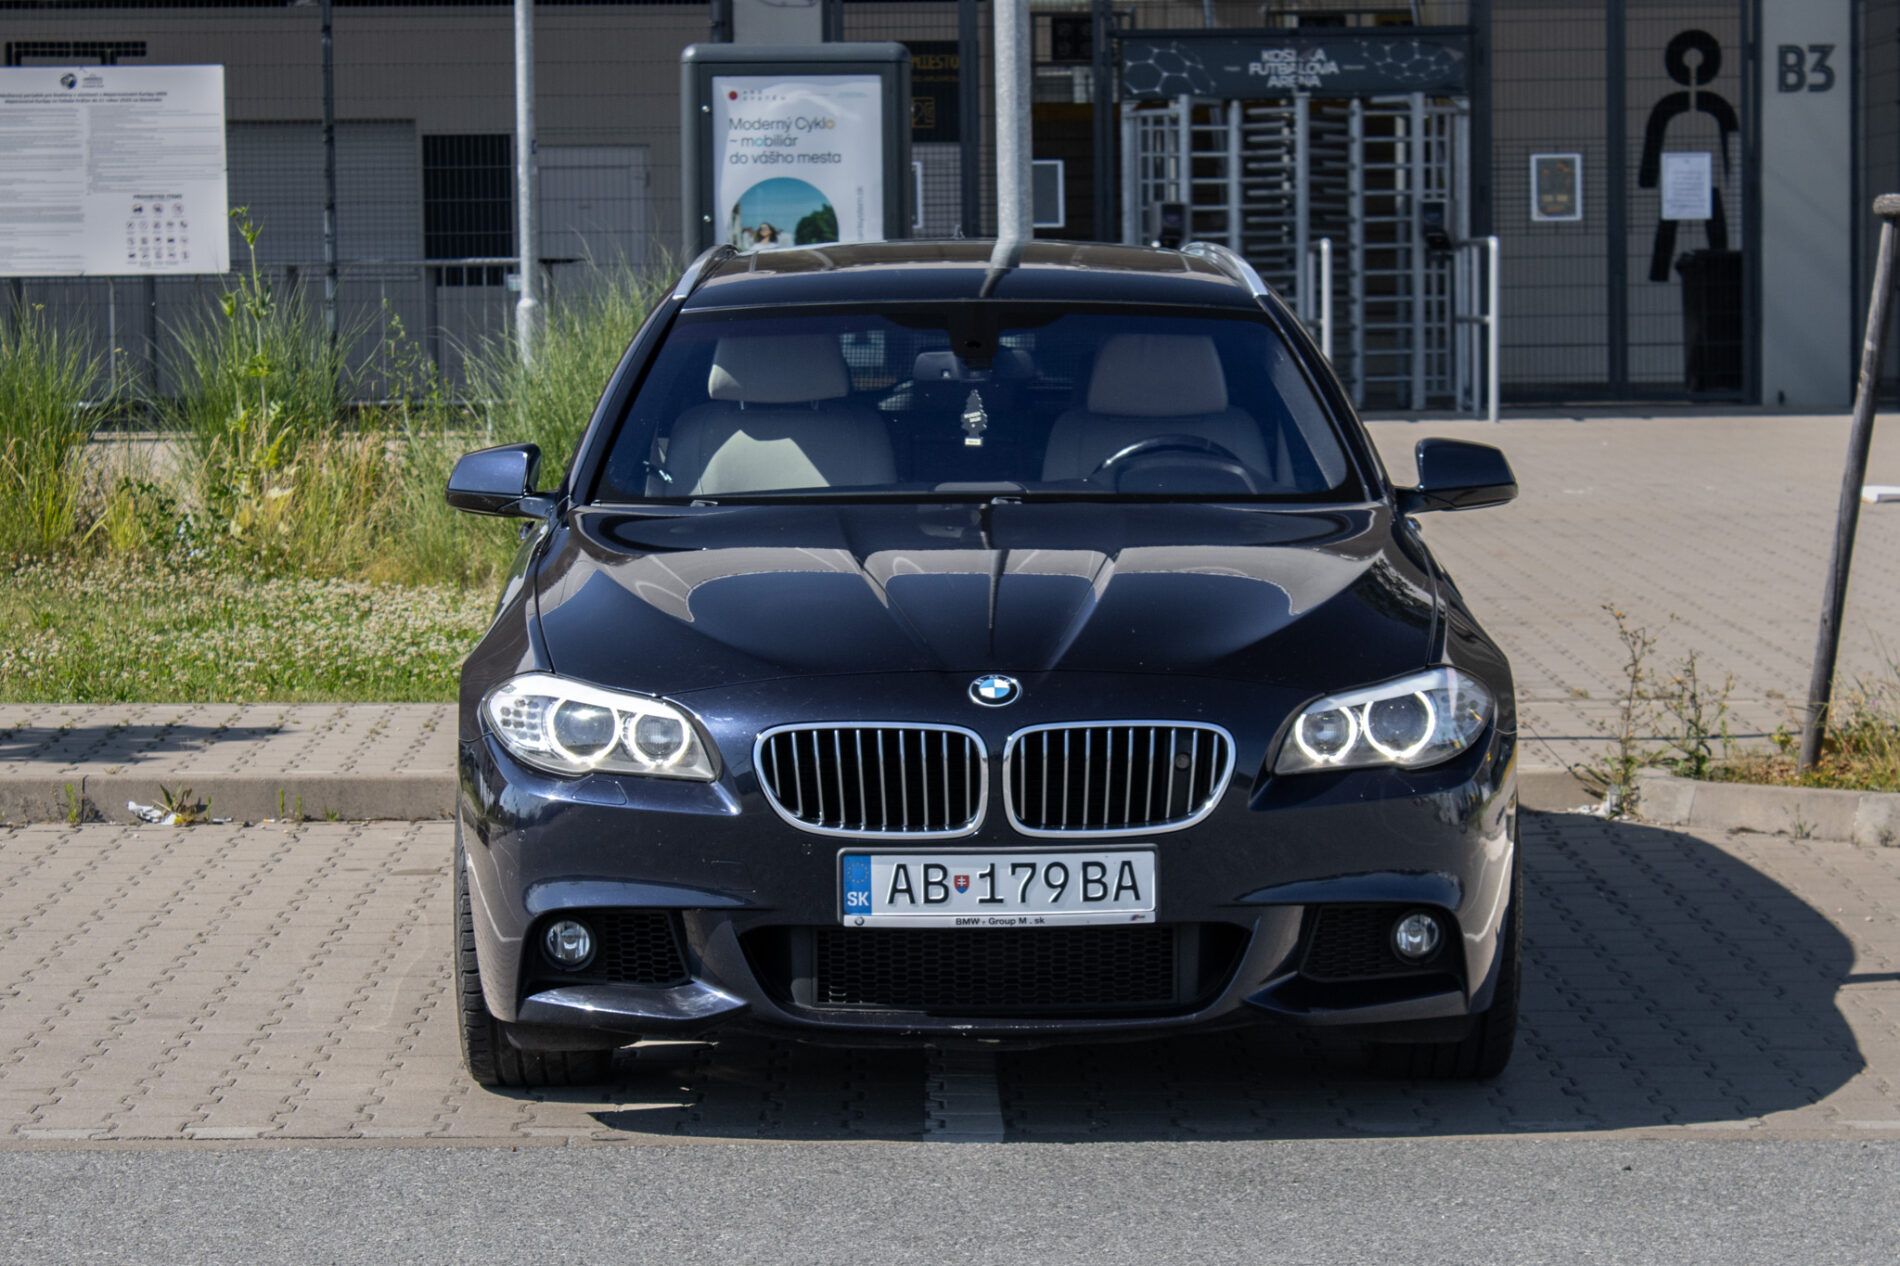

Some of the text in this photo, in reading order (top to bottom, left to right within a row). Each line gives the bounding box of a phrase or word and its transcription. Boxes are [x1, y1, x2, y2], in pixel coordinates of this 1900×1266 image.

[1777, 44, 1836, 93] B3
[729, 117, 836, 133] Moderný Cyklo
[741, 133, 799, 147] mobiliár
[729, 151, 842, 164] do vášho mesta
[847, 891, 870, 907] SK
[955, 917, 980, 926] BMW
[988, 917, 1016, 926] Group
[1018, 917, 1027, 925] M
